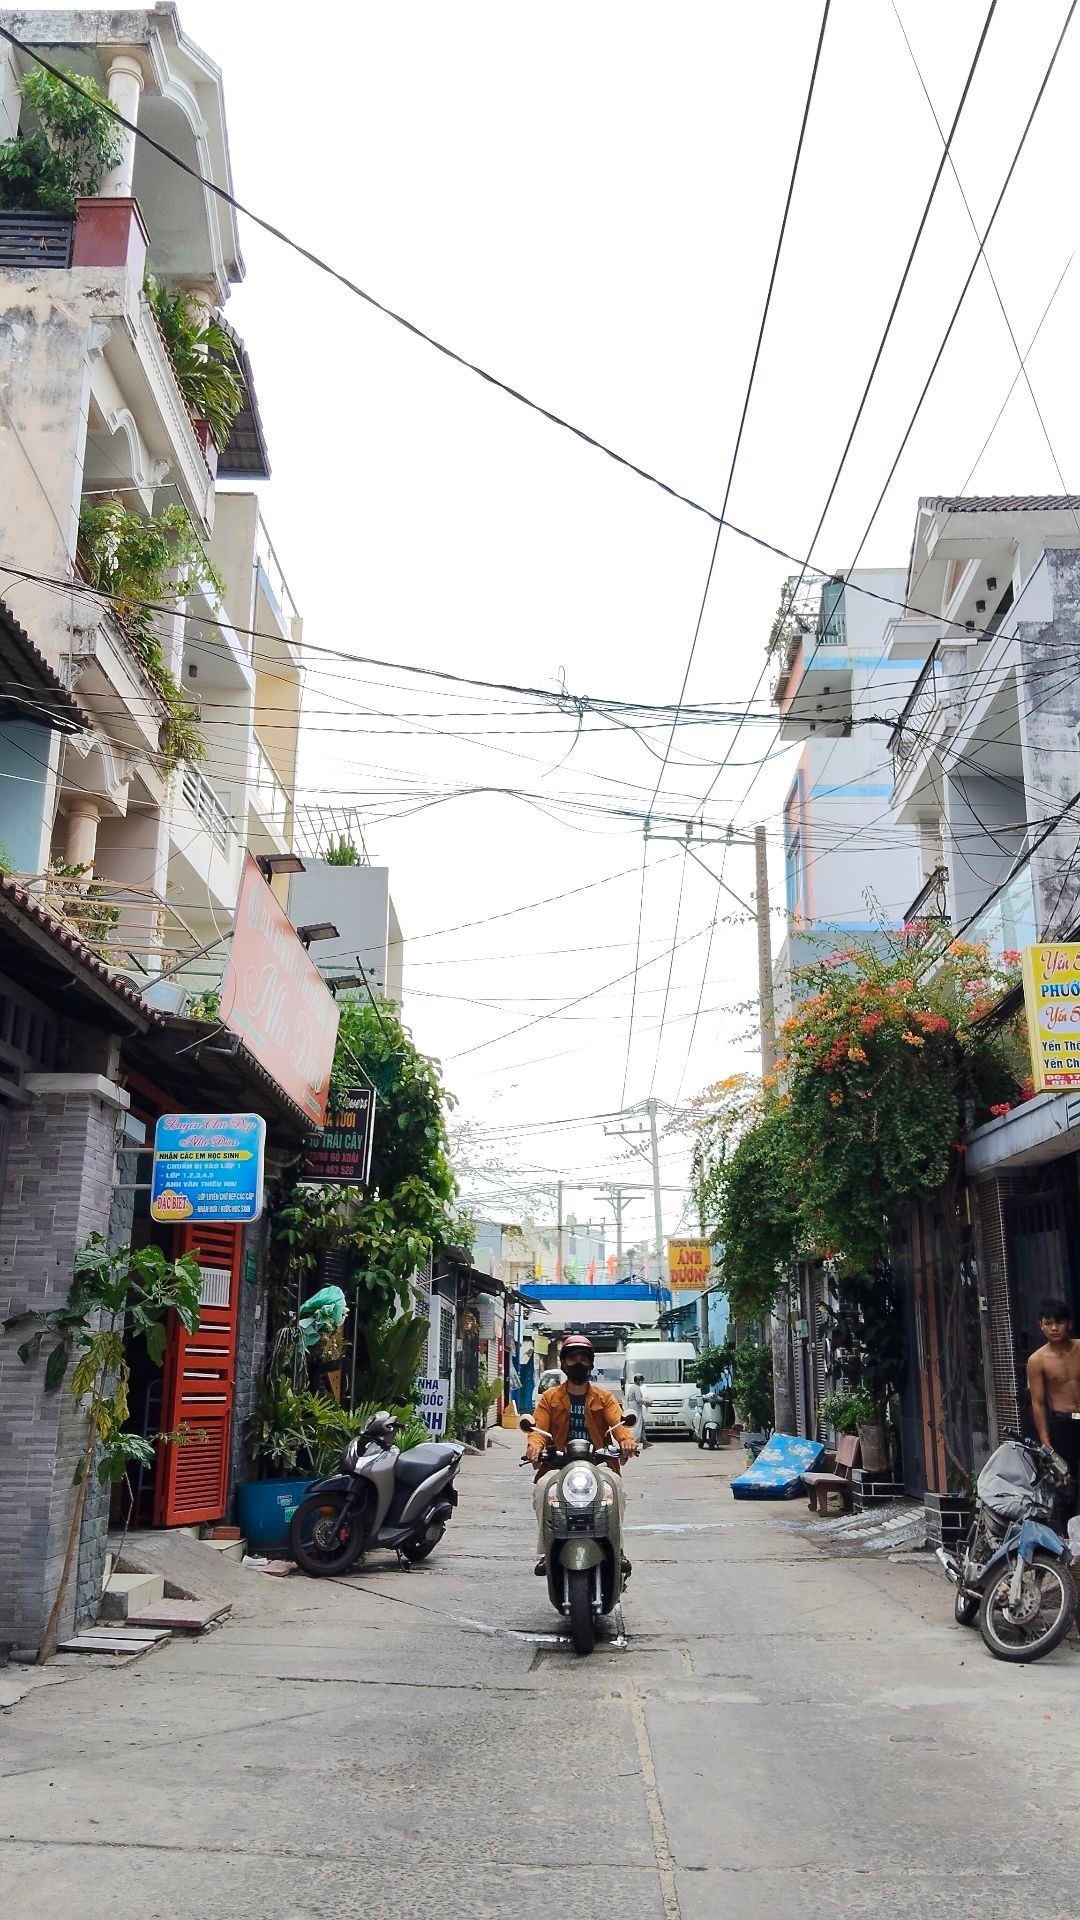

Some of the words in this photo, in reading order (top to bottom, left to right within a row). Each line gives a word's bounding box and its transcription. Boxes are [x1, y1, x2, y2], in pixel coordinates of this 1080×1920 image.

[1041, 951, 1069, 980] Yến
[1042, 1040, 1061, 1051] Yến
[1044, 1057, 1063, 1069] Yến
[344, 1131, 363, 1150] CÂY
[159, 1153, 178, 1161] NHẬN
[180, 1152, 193, 1160] CÁC
[208, 1153, 221, 1161] HỌC
[223, 1152, 240, 1160] SINH
[677, 1248, 703, 1265] ÁNH
